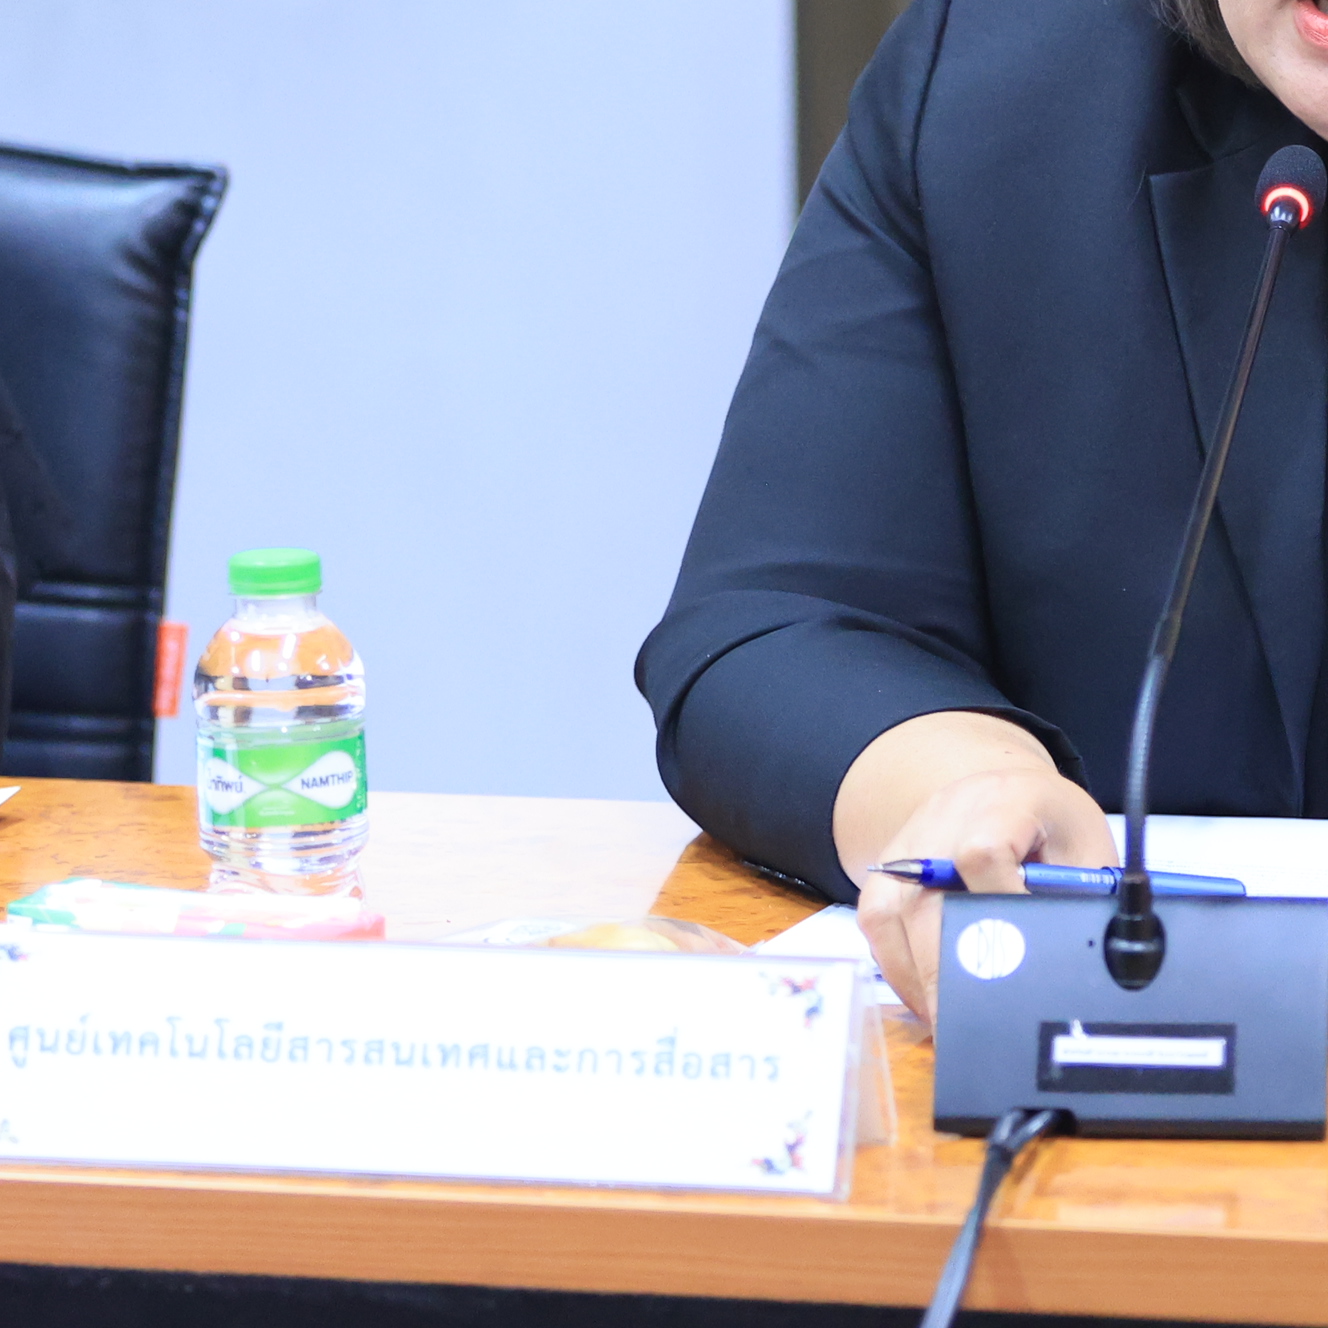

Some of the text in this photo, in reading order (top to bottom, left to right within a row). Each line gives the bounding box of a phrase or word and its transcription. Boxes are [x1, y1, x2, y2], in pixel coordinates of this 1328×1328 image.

[301, 771, 353, 789] NAMTHIP
[7, 1014, 782, 1083] ศูนย์เทคโนโลยีสารสนเทศและการสื่อสาร
